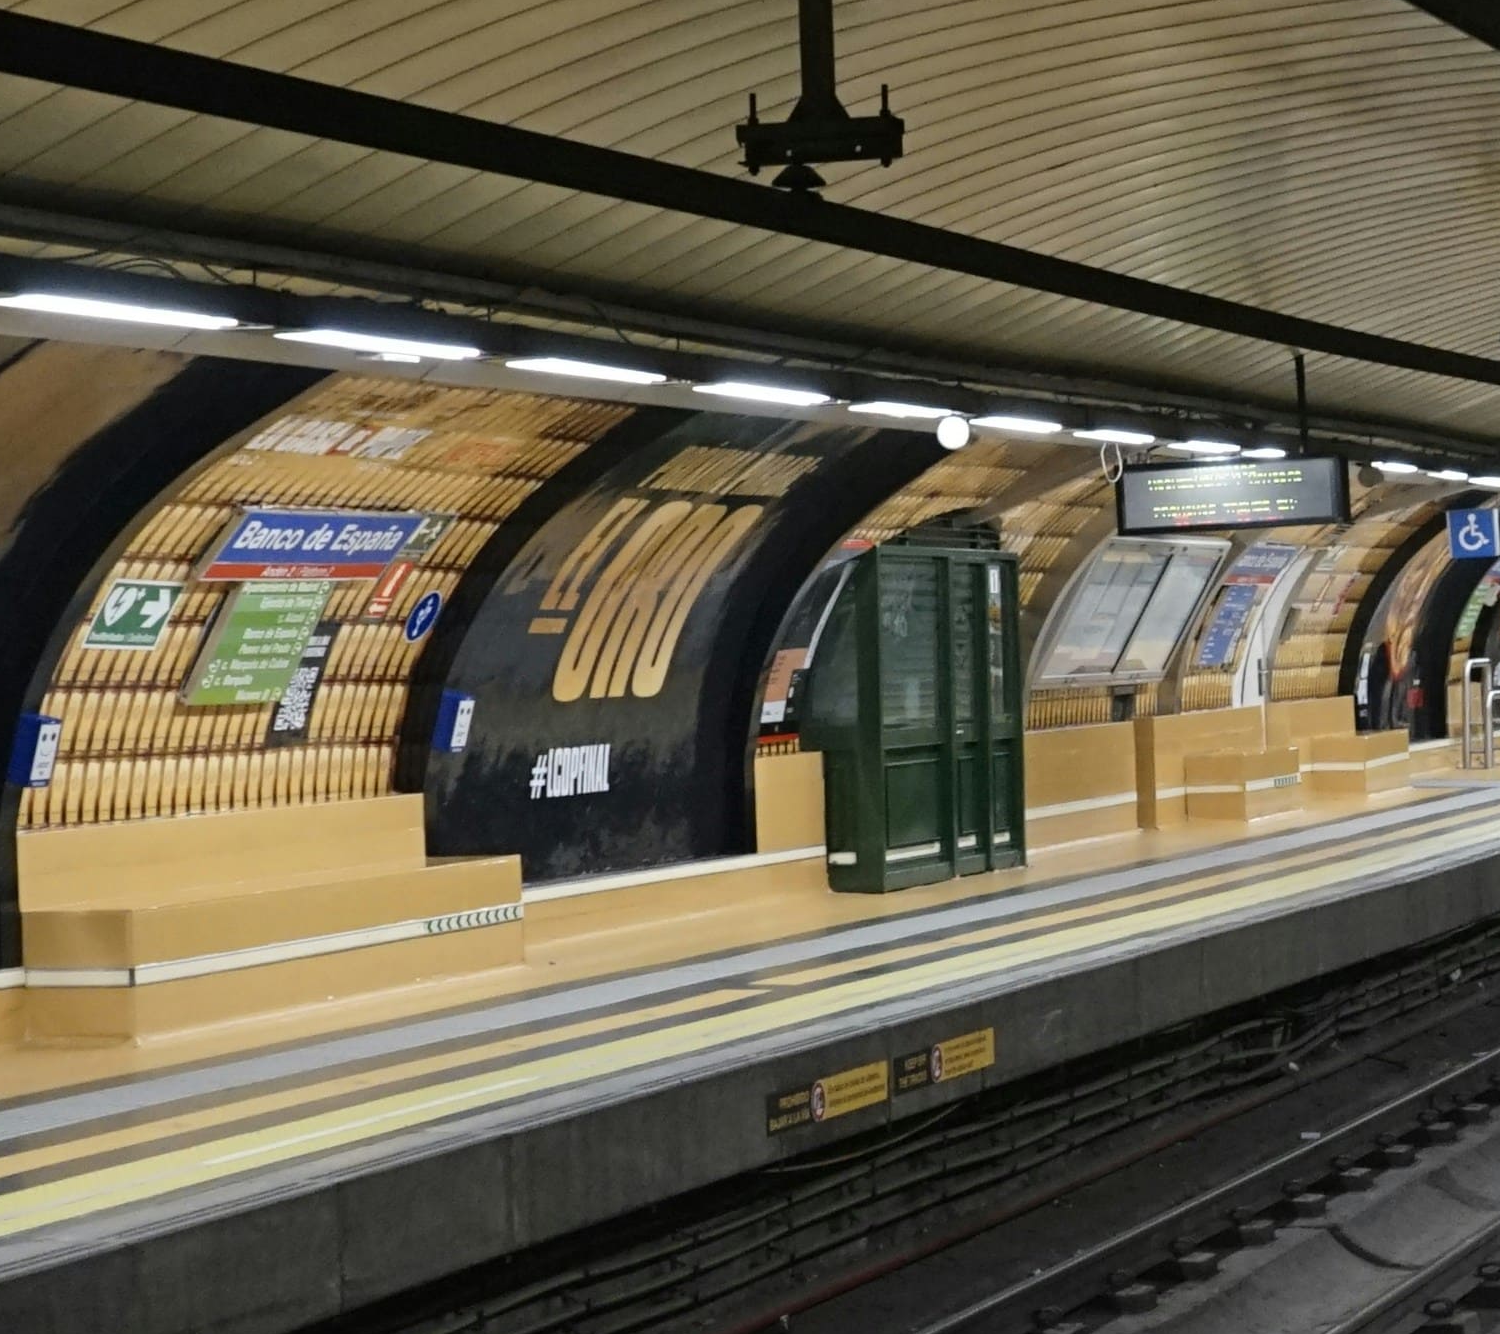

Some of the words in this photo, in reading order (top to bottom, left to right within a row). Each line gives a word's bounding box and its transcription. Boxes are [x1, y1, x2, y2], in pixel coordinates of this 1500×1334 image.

[232, 519, 300, 550] Banco
[302, 522, 334, 551] de
[329, 523, 404, 556] España
[552, 500, 765, 703] ORO
